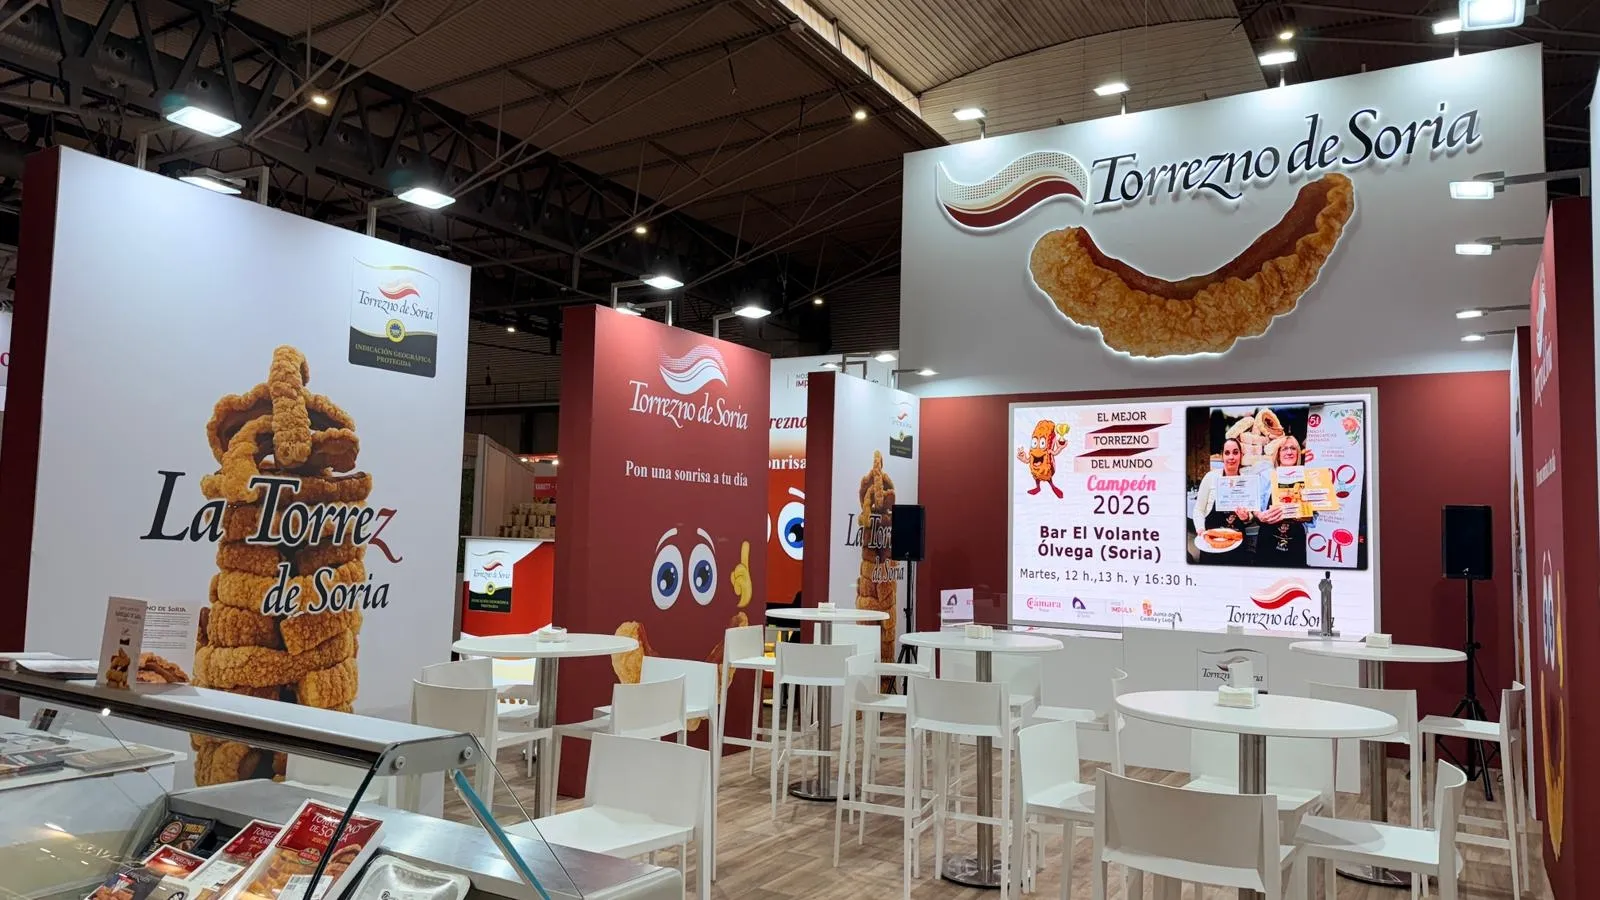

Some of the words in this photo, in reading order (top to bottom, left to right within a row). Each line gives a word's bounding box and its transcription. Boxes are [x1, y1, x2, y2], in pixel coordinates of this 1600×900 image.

[1092, 146, 1280, 204] Torrezno
[1287, 113, 1340, 174] de
[1342, 102, 1481, 165] Soria
[359, 289, 399, 315] Torrezno
[400, 299, 409, 314] de
[410, 303, 434, 320] Soria
[355, 343, 393, 356] INDICACIÓN
[376, 355, 412, 367] PROTEGIDA
[629, 380, 696, 429] Torrezno
[698, 392, 714, 424] de
[713, 397, 749, 430] Soria
[769, 416, 808, 430] rezno
[1097, 412, 1109, 422] EL
[1111, 411, 1147, 421] MEJOR
[1093, 434, 1150, 446] TORREZNO
[769, 455, 807, 470] nrisa
[1091, 460, 1110, 469] DEL
[1112, 458, 1153, 469] MUNDO
[625, 460, 648, 478] Pon
[651, 466, 672, 480] una
[674, 469, 711, 484] sonrisa
[713, 474, 719, 484] a
[722, 472, 732, 485] tu
[734, 472, 748, 487] día
[1087, 474, 1157, 496] Campeón
[1093, 495, 1150, 515] 2026
[140, 470, 226, 543] La
[246, 477, 403, 564] Torrez
[845, 513, 864, 547] La
[1040, 525, 1067, 539] Bar
[1073, 526, 1087, 539] El
[1094, 527, 1160, 541] Volante
[1038, 540, 1094, 561] Ólvega
[1101, 545, 1161, 563] (Soria)
[883, 559, 904, 582] Soria
[1020, 568, 1060, 581] Martes,
[1066, 570, 1078, 581] 12
[1117, 573, 1128, 583] h.
[1133, 575, 1140, 586] y
[1145, 574, 1180, 586] 16:30
[1186, 575, 1197, 586] h.
[262, 564, 300, 614] de
[309, 568, 390, 614] Soria
[1226, 604, 1282, 630] Torrezno
[1284, 606, 1299, 627] de
[1202, 668, 1230, 681] Torrezn
